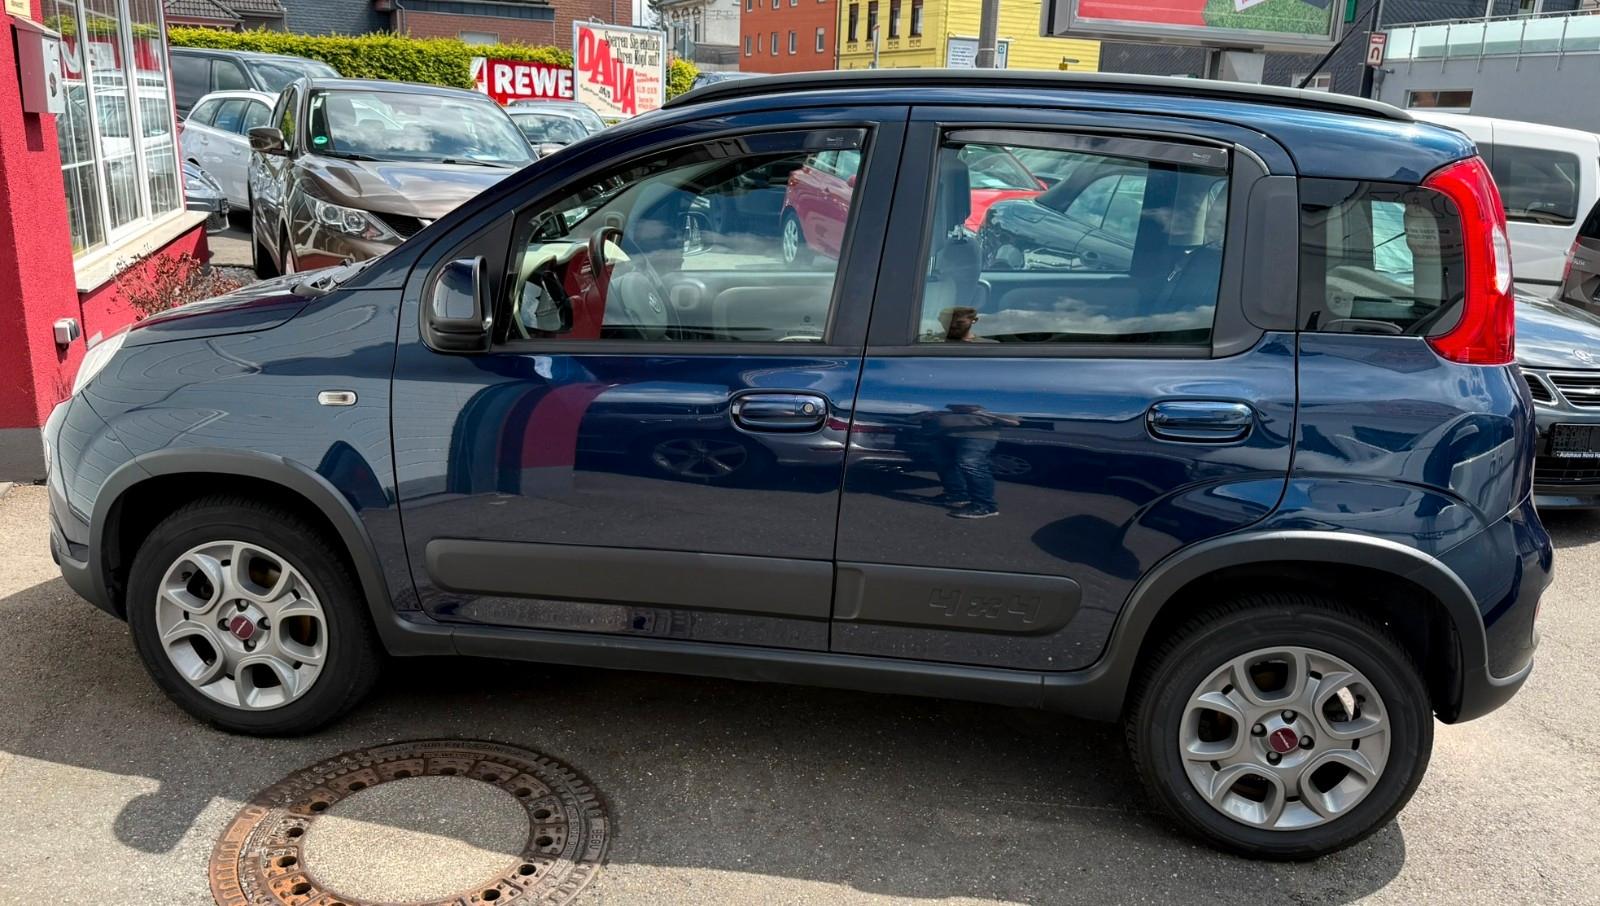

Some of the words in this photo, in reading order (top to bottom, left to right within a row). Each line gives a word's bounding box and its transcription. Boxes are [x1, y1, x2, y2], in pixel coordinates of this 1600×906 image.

[630, 33, 639, 49] Sie
[494, 64, 573, 97] REWE
[589, 829, 604, 850] BEGU
